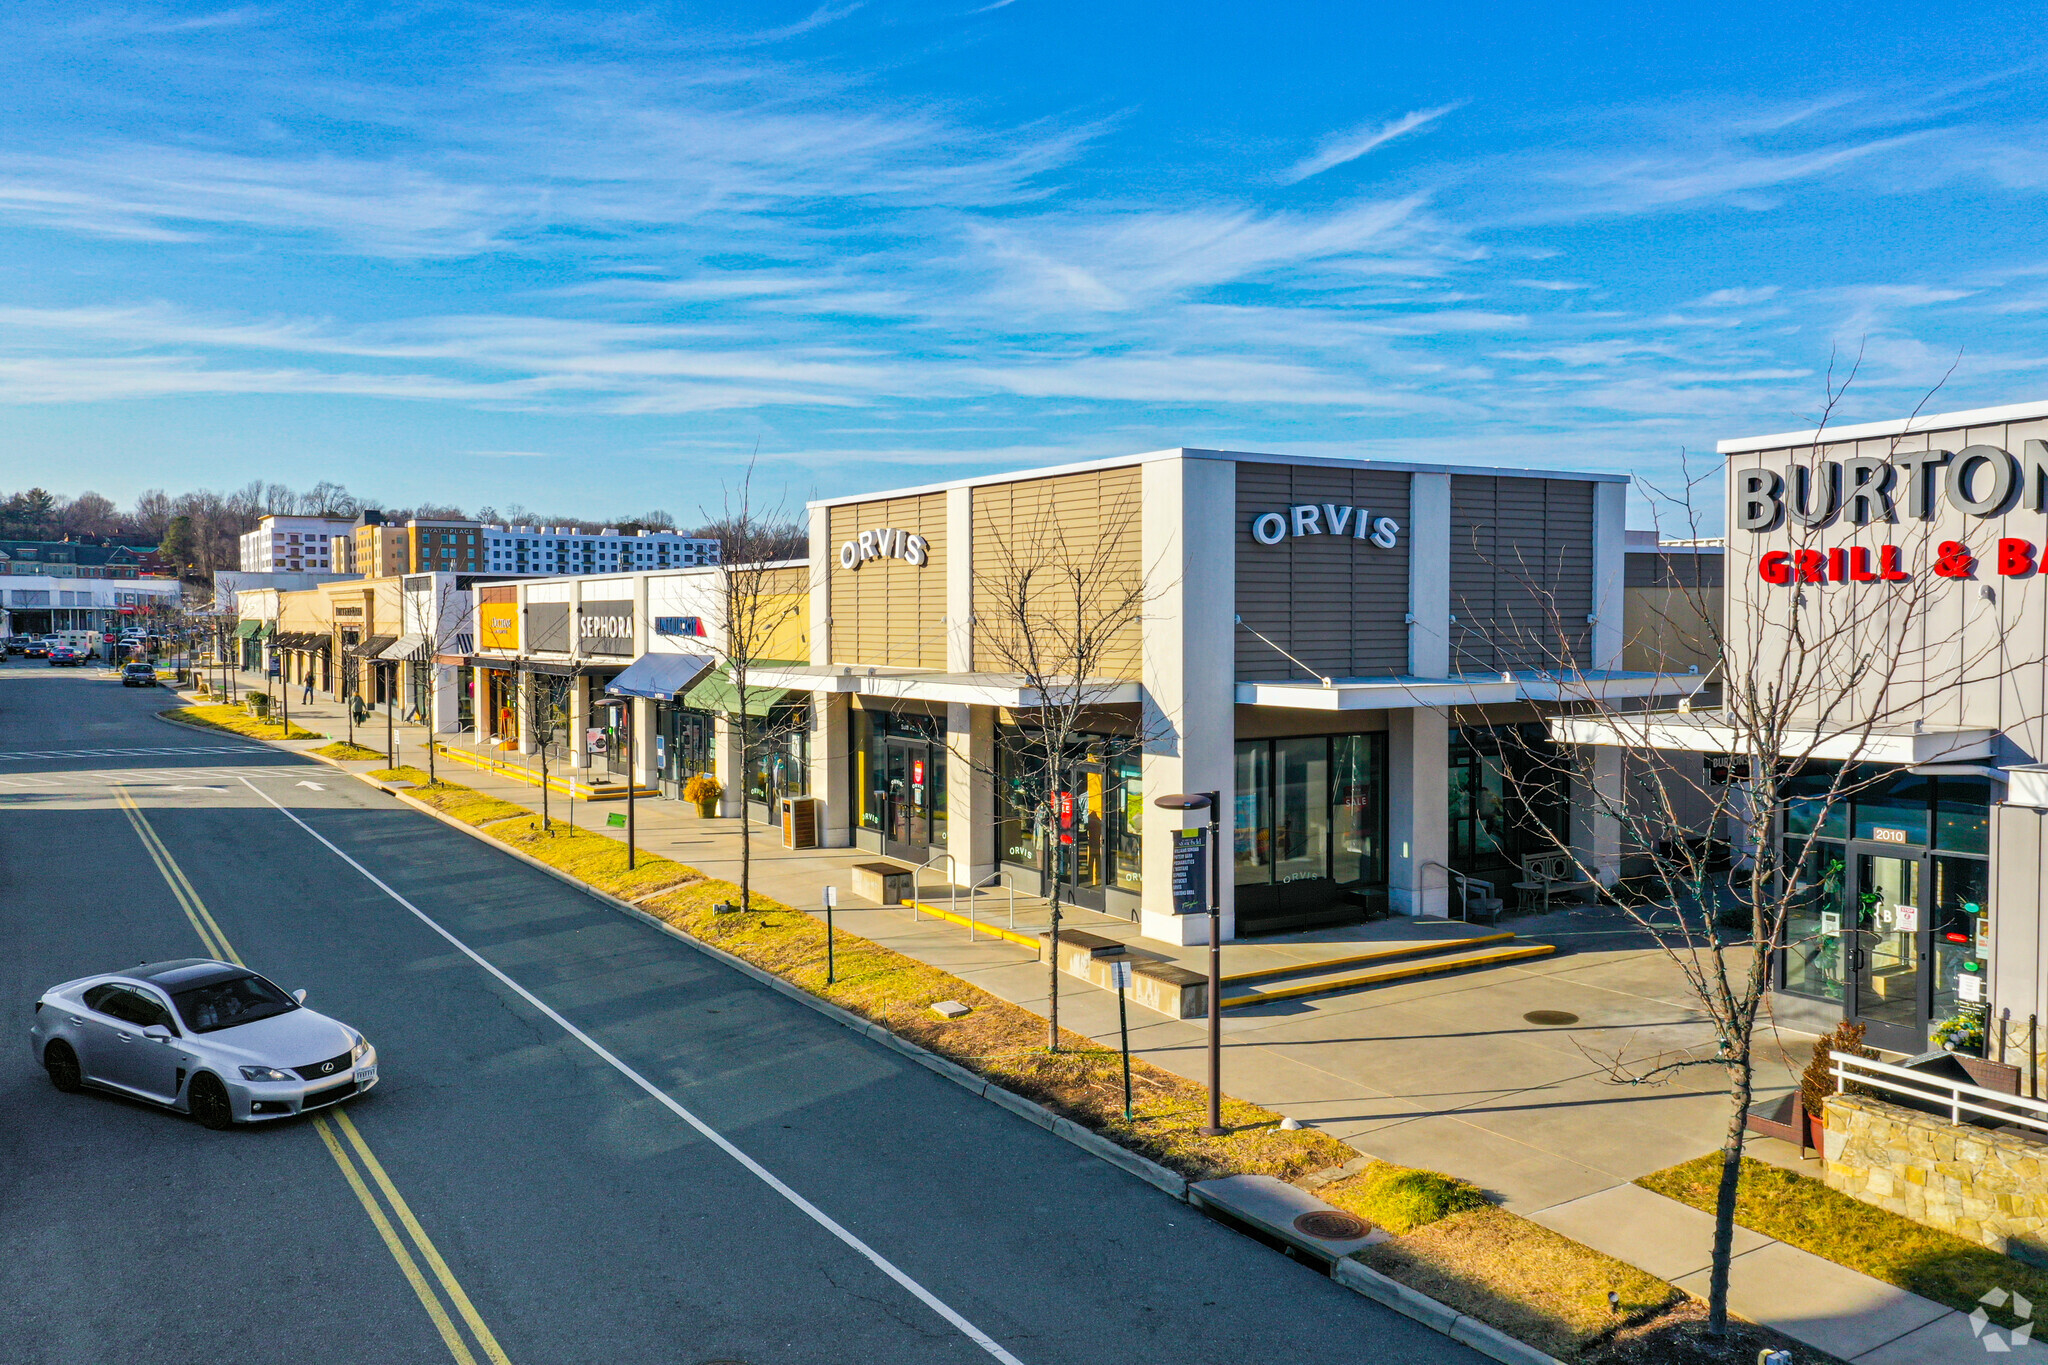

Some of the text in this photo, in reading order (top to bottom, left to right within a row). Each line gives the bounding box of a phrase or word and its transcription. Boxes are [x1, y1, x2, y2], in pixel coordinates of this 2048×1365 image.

[1252, 503, 1400, 549] ORVIS
[840, 527, 926, 569] ORVIS
[1759, 537, 2048, 584] GRILL & B
[580, 615, 634, 639] SEPHORA
[1712, 755, 1750, 768] BURONS
[1345, 797, 1367, 807] SALE
[1875, 829, 1904, 841] 2010
[1009, 846, 1033, 860] ORVIS
[1283, 871, 1318, 884] ORVIS
